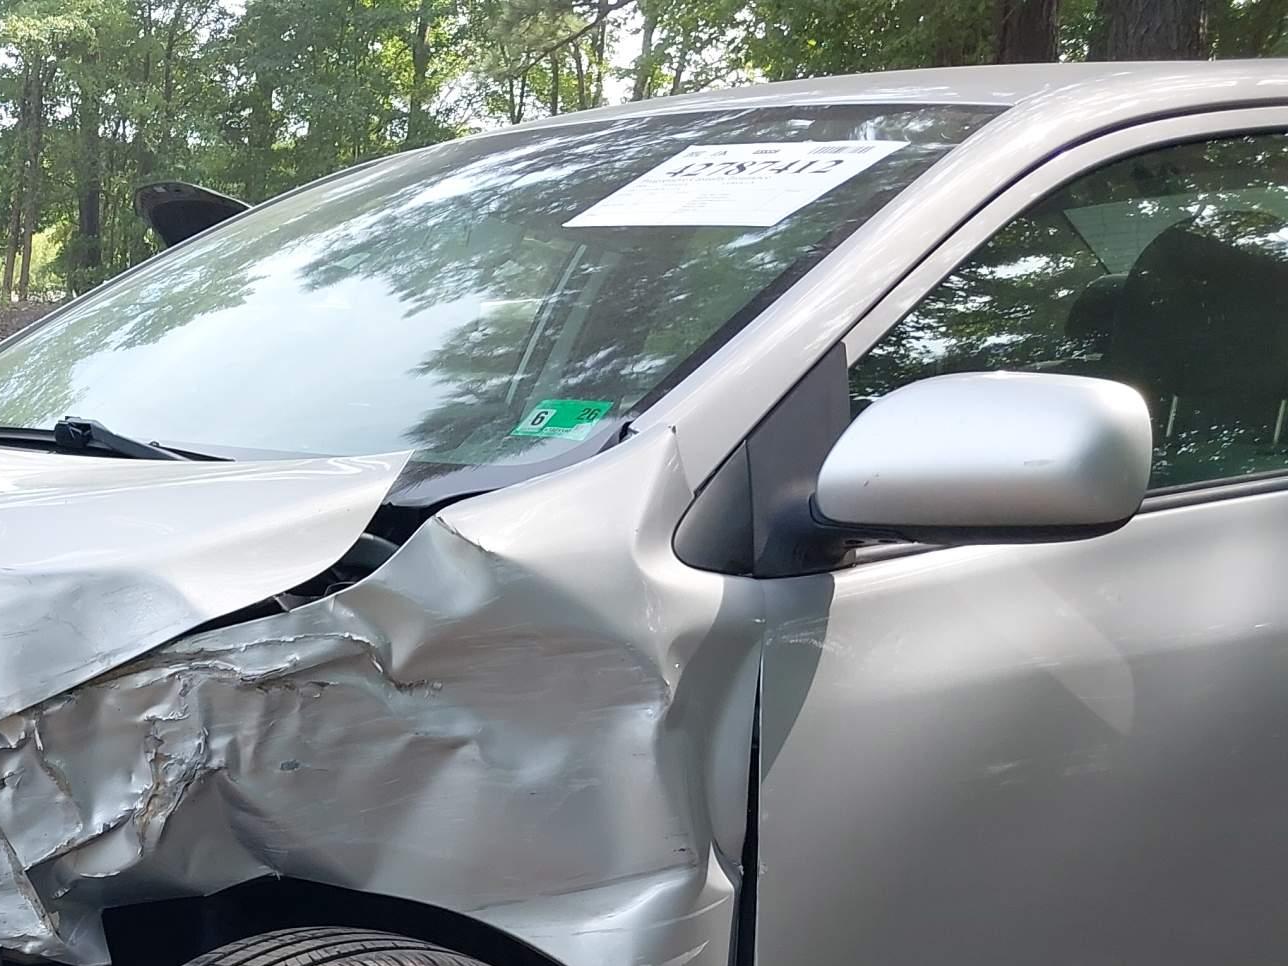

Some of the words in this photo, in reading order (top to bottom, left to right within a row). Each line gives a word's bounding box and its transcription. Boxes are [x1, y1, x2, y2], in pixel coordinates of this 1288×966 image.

[665, 159, 845, 178] 42787412
[530, 410, 549, 426] 6
[577, 407, 601, 421] 26
